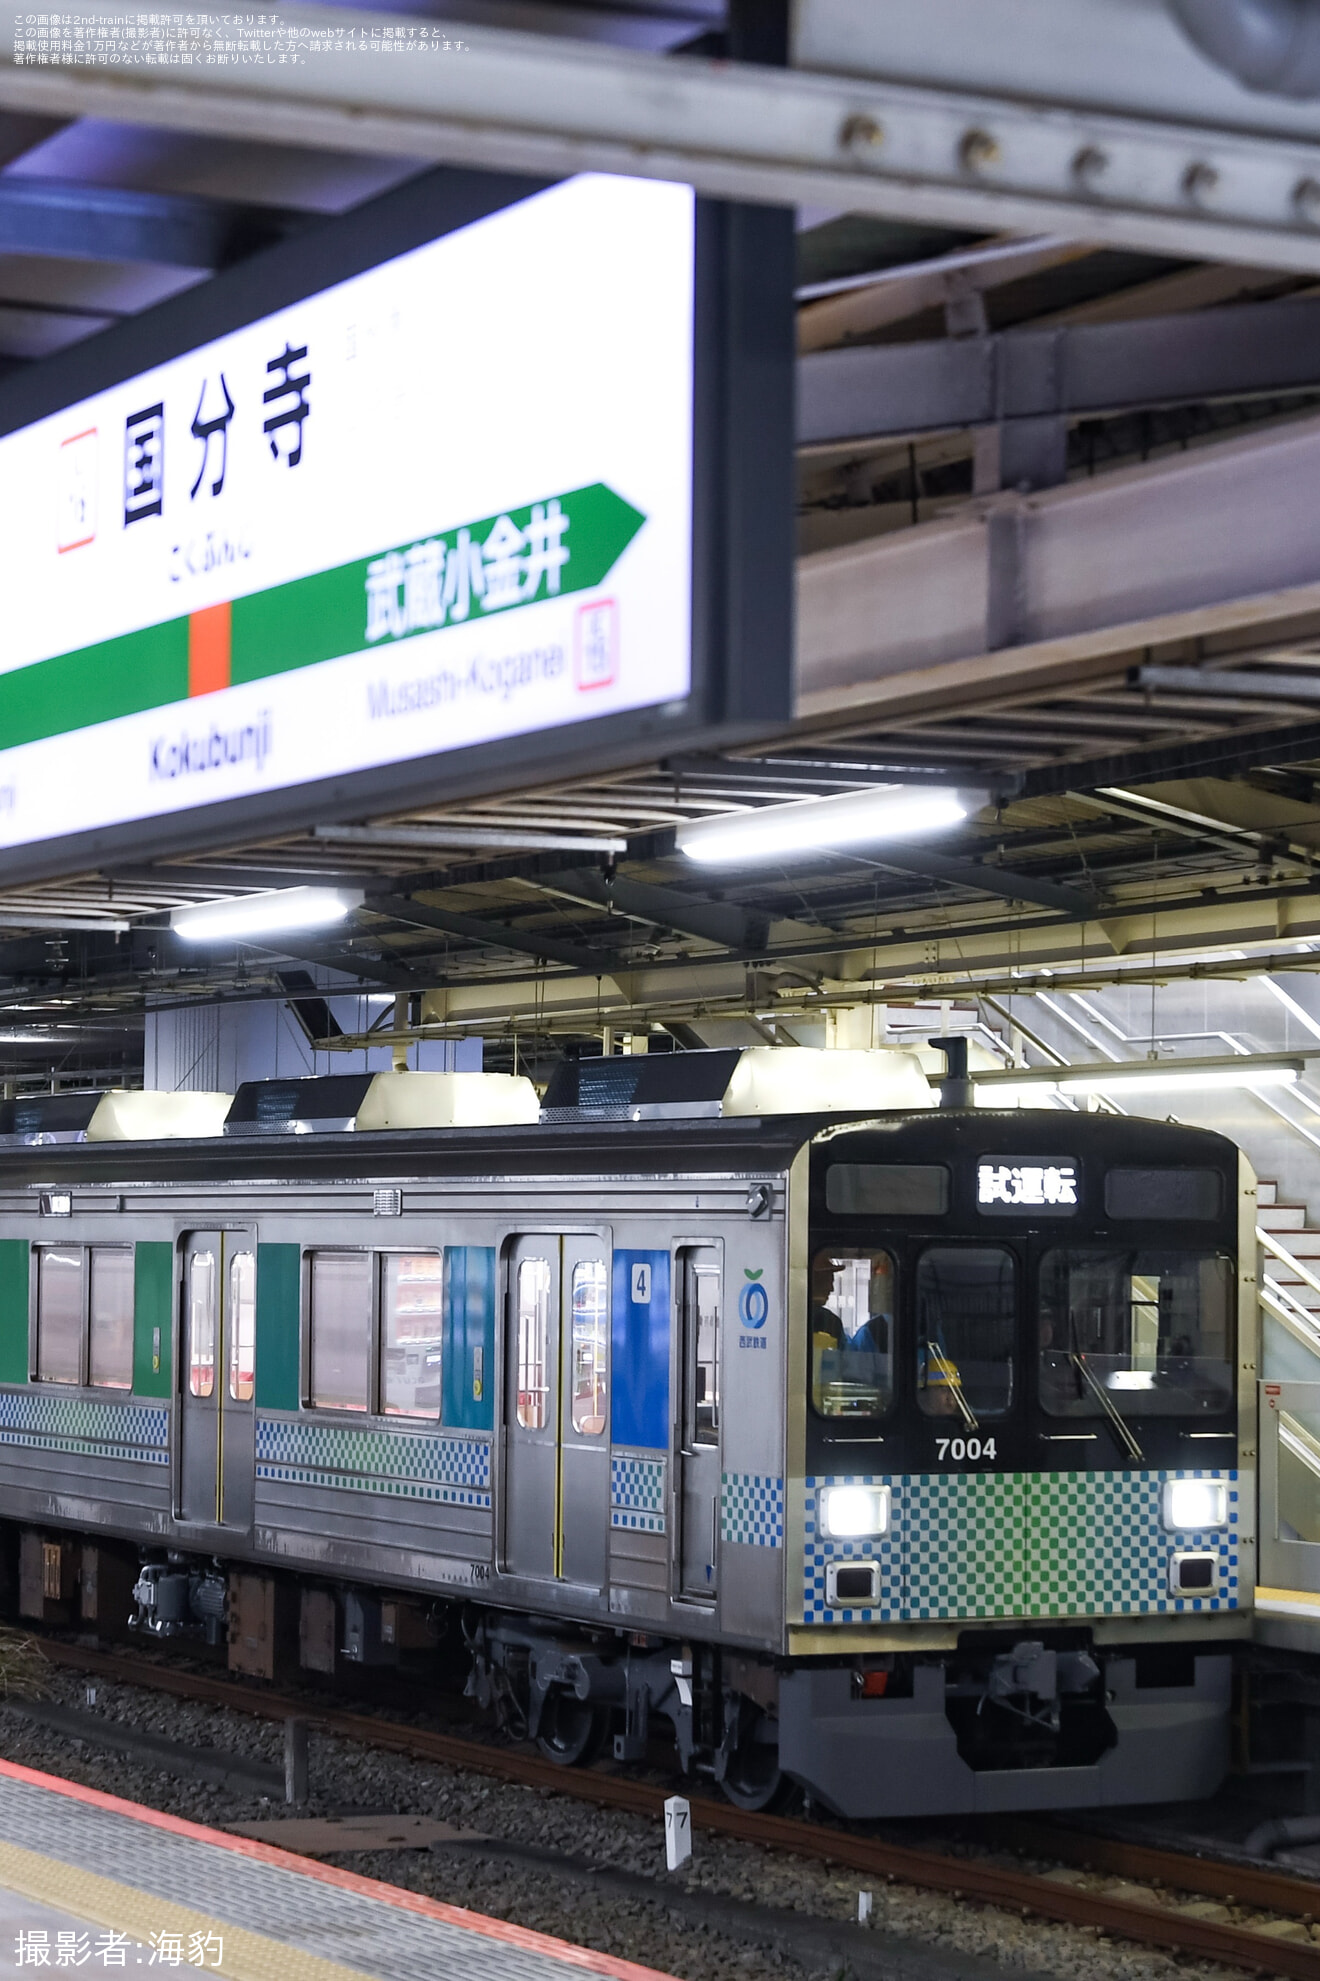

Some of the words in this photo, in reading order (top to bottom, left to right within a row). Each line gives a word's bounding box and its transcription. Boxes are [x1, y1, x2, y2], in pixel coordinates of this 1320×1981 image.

[124, 342, 311, 528] 国分寺
[364, 498, 571, 643] 武蔵小金井
[149, 707, 273, 784] Kokubunji
[978, 1165, 1078, 1204] 試運転
[636, 1269, 647, 1297] 4
[935, 1437, 997, 1461] 7004
[470, 1563, 490, 1580] 7004
